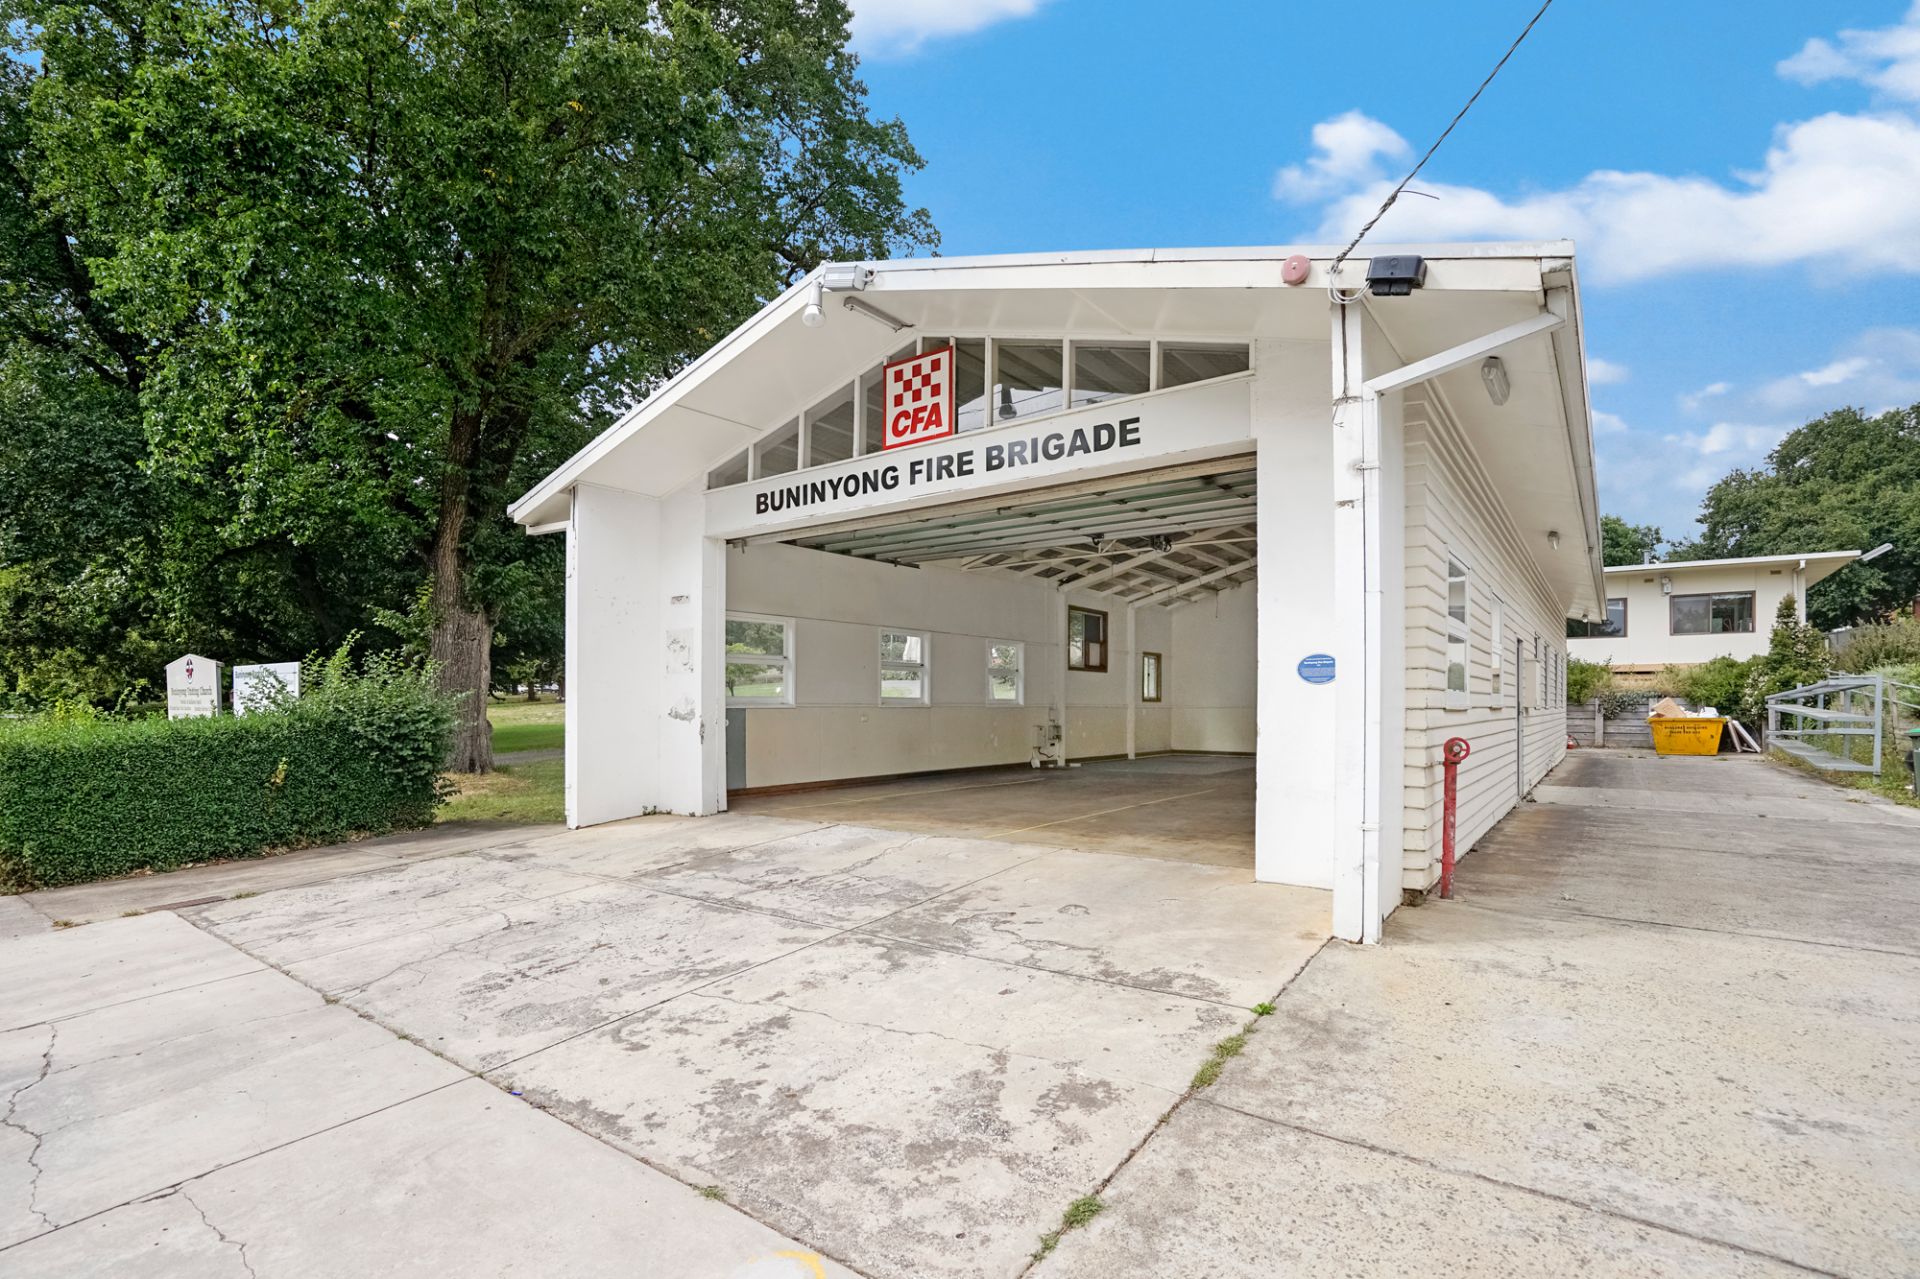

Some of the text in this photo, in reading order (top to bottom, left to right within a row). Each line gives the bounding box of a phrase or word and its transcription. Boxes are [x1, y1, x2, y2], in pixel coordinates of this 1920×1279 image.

[891, 402, 943, 438] CFA
[756, 416, 1141, 515] BUNINYONG FIRE BRIGADE
